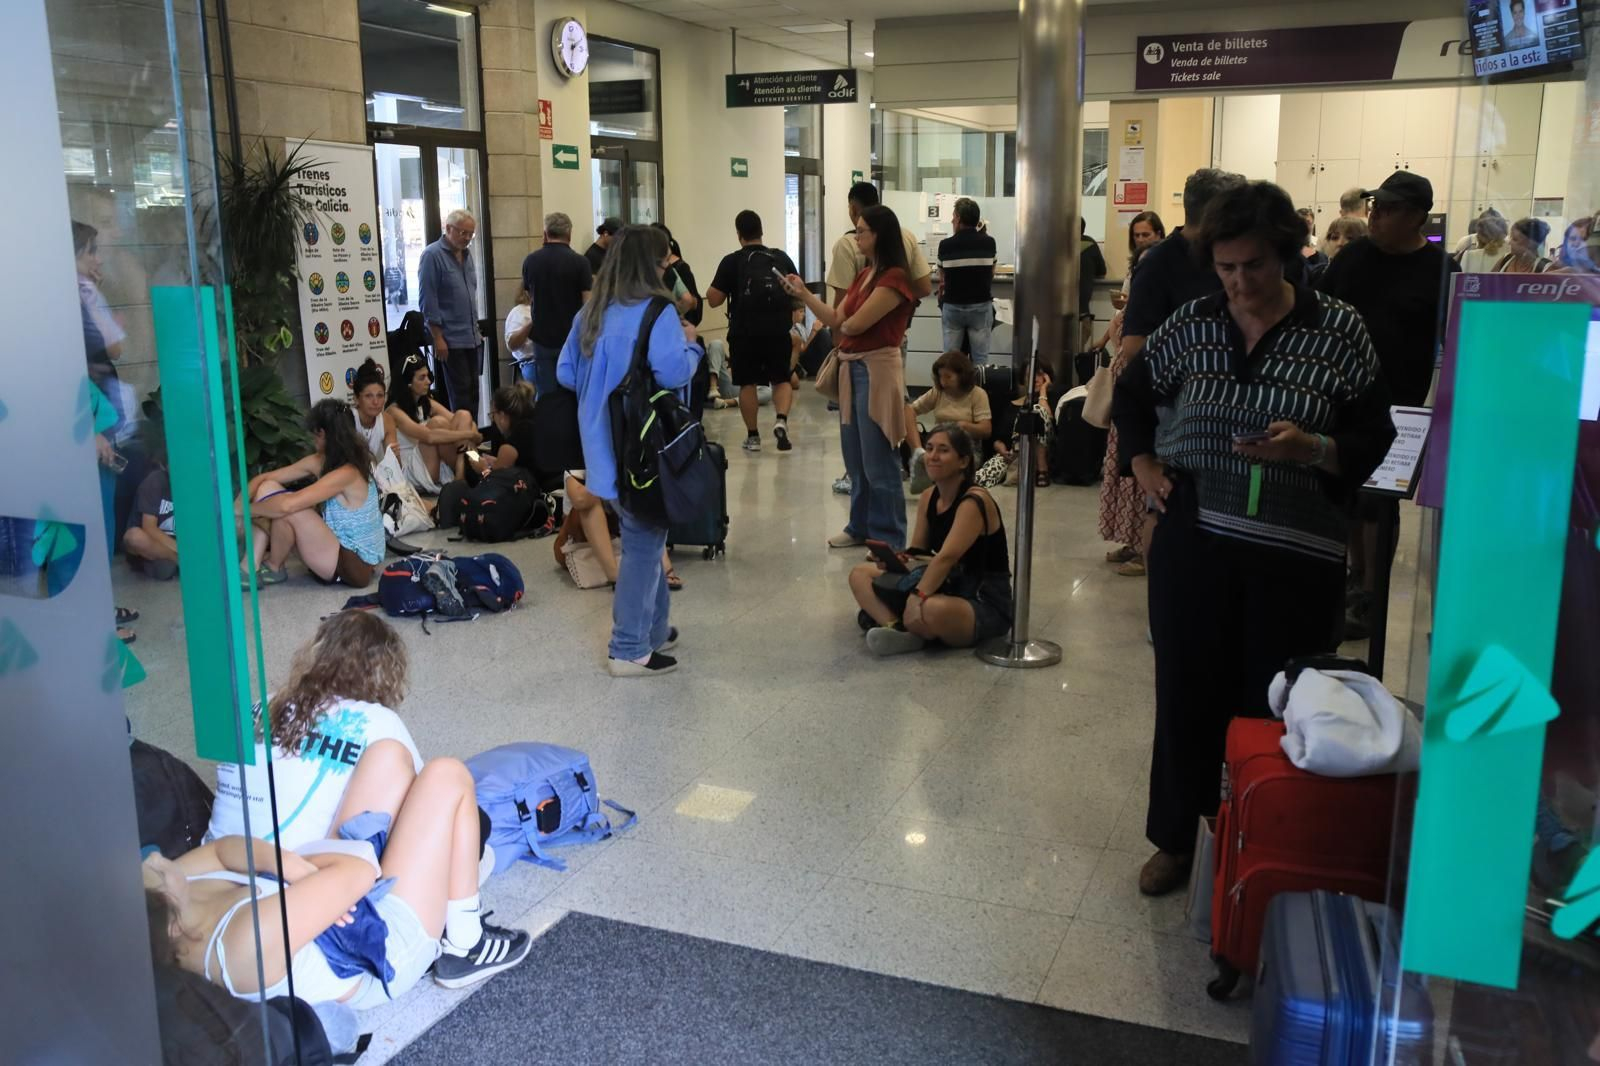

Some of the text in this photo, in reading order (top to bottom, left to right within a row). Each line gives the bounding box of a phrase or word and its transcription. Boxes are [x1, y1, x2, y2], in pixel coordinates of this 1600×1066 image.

[1172, 38, 1268, 53] Venta de billetes
[1171, 55, 1248, 67] Venda de billetes
[1501, 60, 1507, 69] a
[1509, 53, 1519, 67] la
[754, 74, 818, 84] Atención al cliente
[1170, 71, 1221, 82] Tickets sale
[754, 85, 785, 95] Atención
[797, 85, 822, 93] cliente
[828, 88, 856, 98] adif
[929, 206, 938, 217] 3
[1516, 277, 1581, 302] renfe
[304, 732, 361, 766] THE
